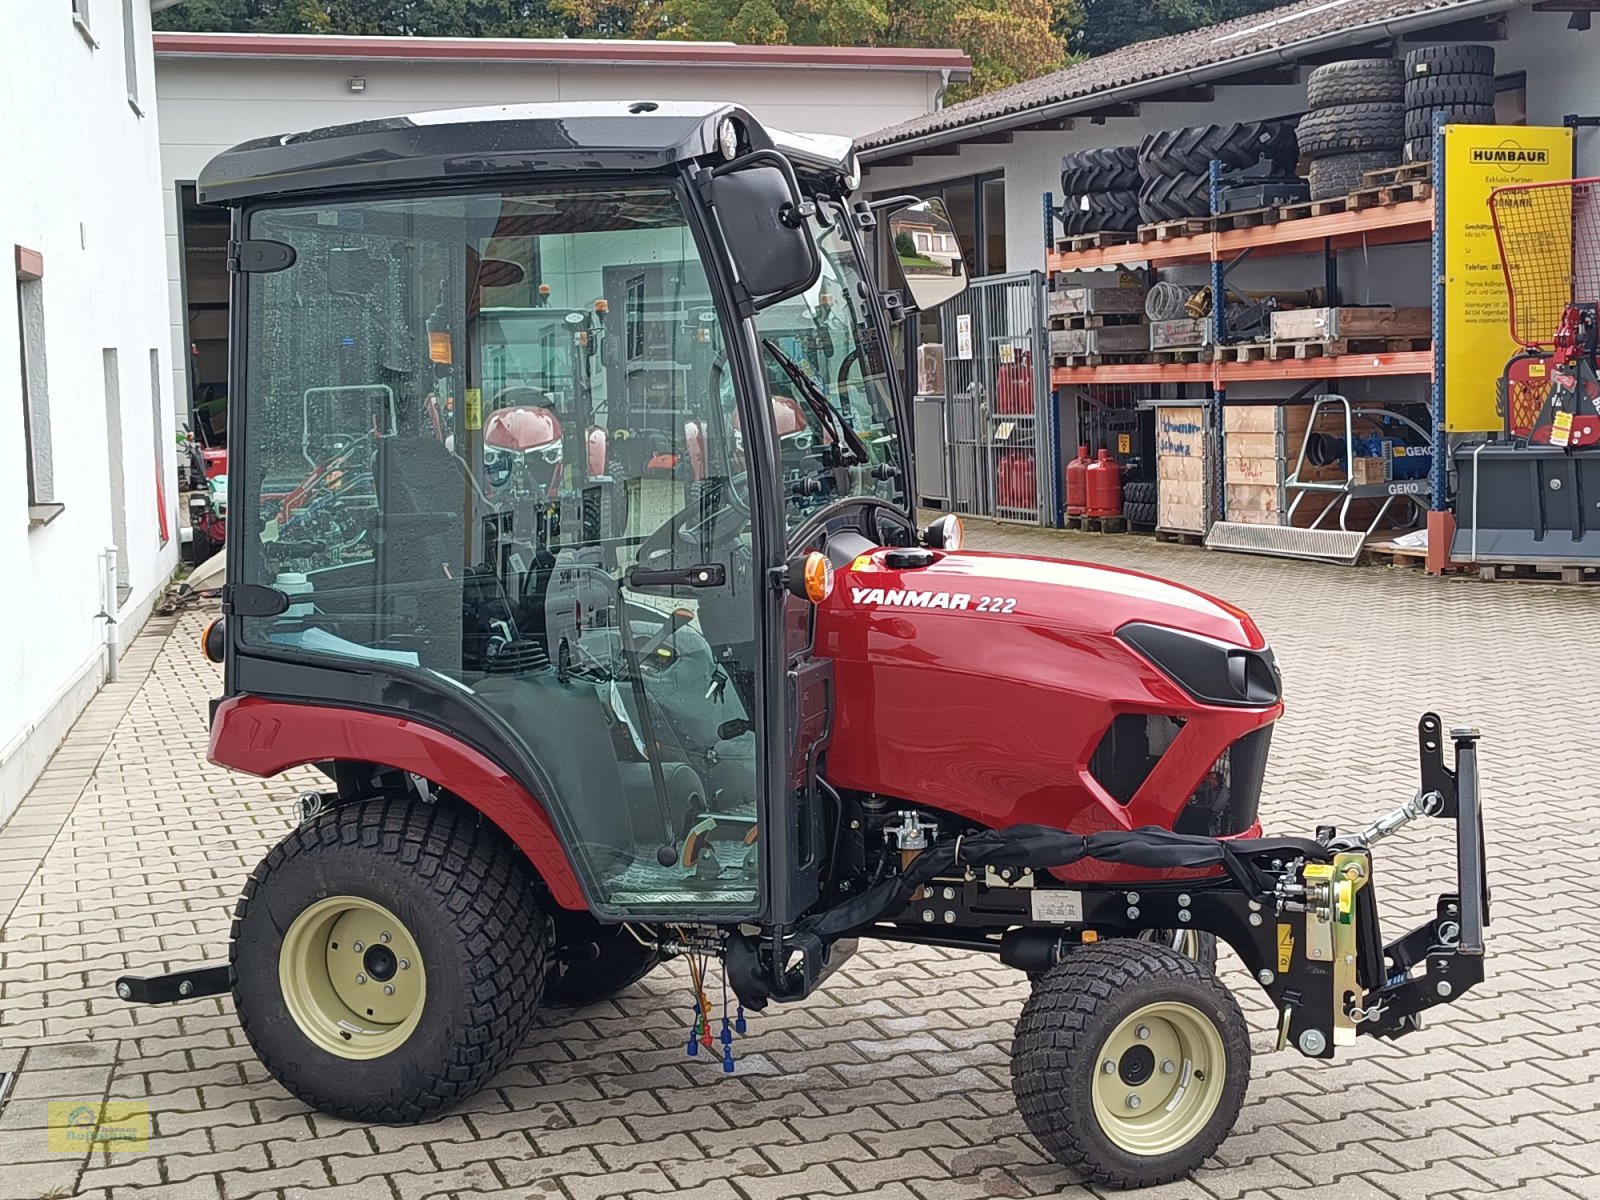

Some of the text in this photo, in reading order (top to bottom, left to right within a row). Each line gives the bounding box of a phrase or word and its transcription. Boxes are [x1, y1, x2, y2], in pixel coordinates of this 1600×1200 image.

[1473, 150, 1546, 162] HUMBAUR
[1464, 263, 1489, 271] Telefon:
[1388, 482, 1419, 495] GEKO
[850, 587, 1017, 614] YANMAR 222
